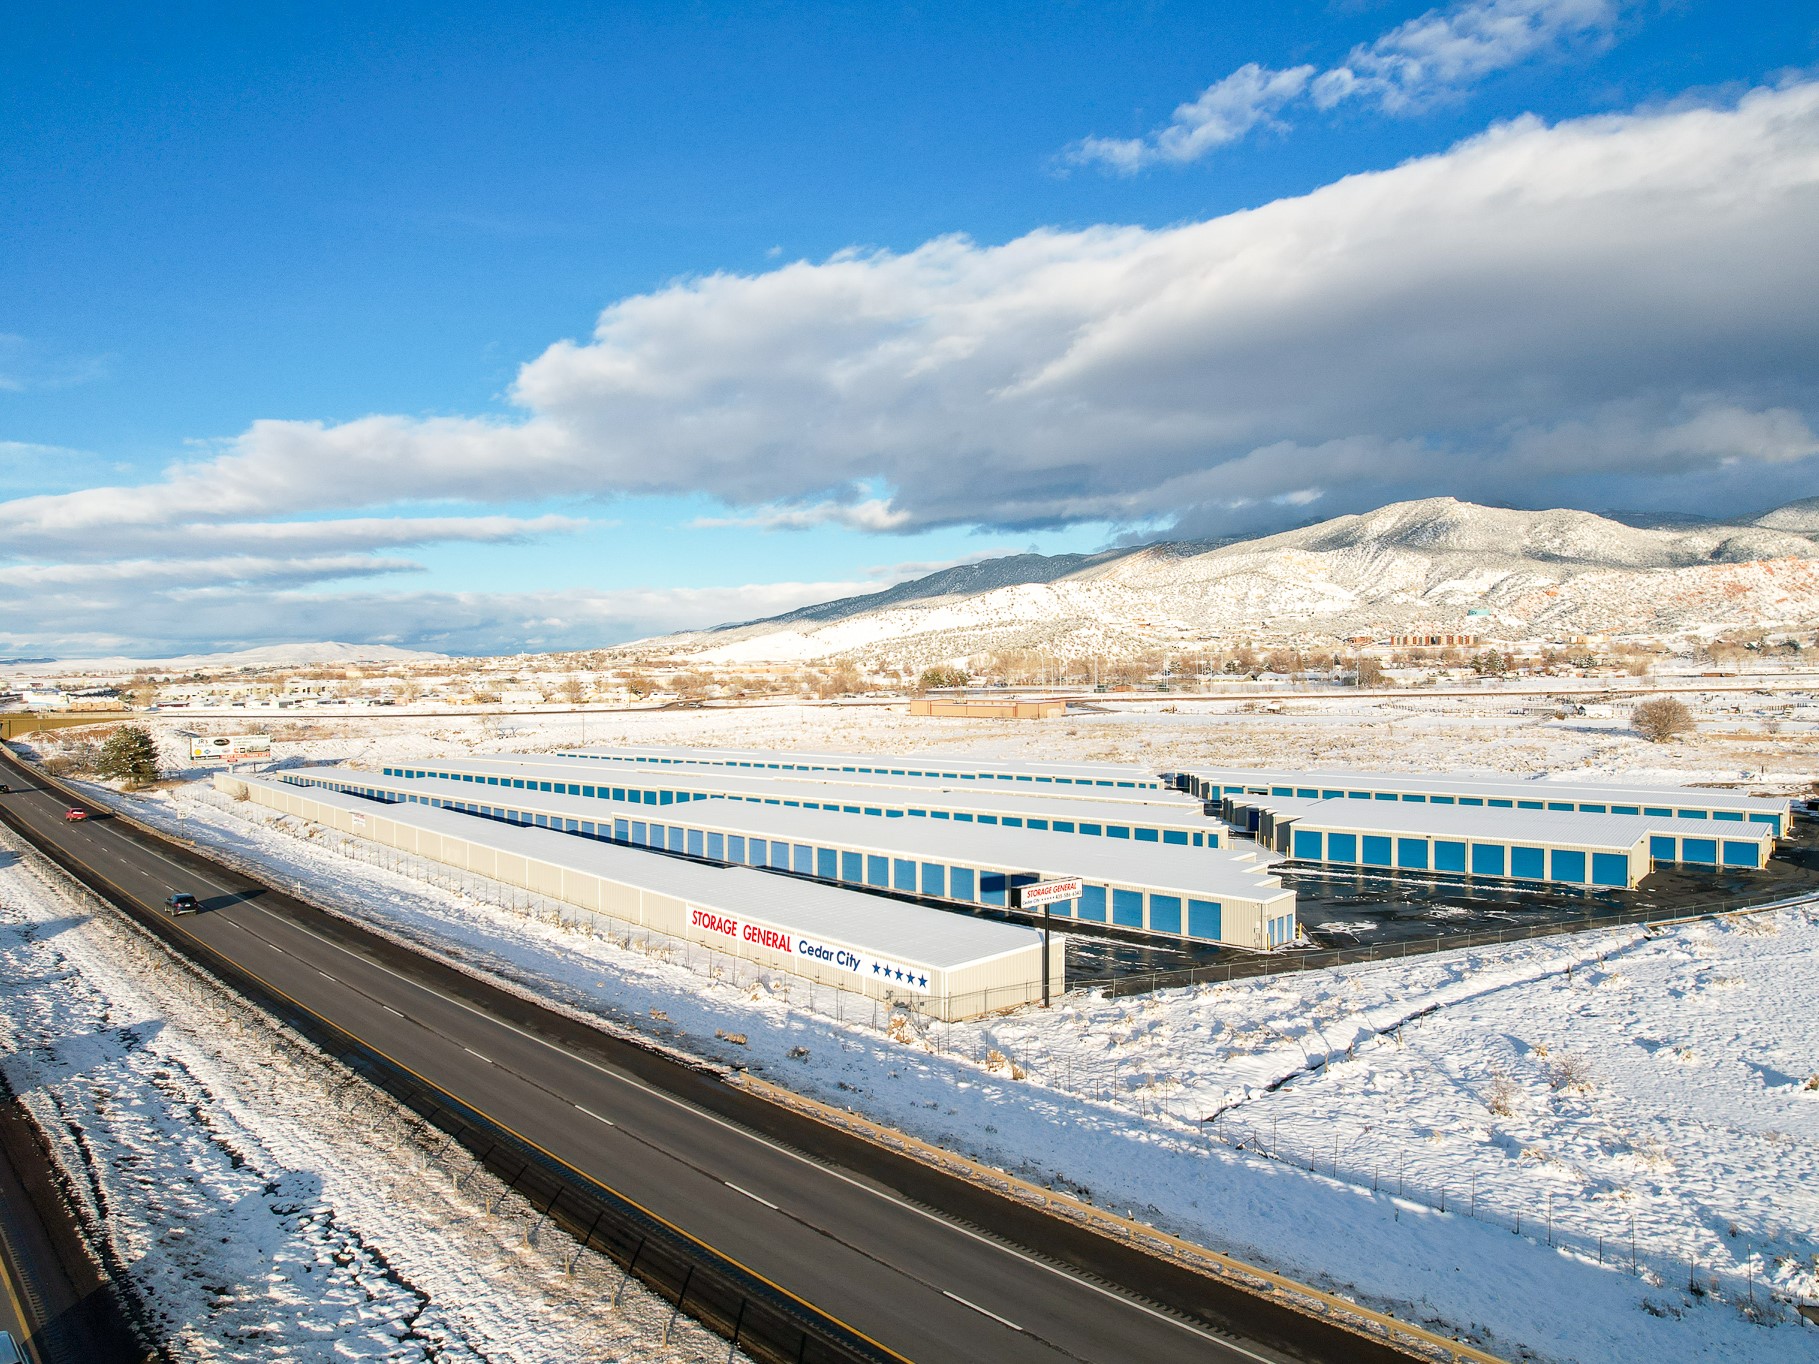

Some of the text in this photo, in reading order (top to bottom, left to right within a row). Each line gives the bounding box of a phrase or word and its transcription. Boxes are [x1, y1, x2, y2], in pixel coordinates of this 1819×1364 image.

[1027, 882, 1076, 898] STORAGE GENERAL
[692, 910, 861, 972] STORAGE GENERAL Cedar City
